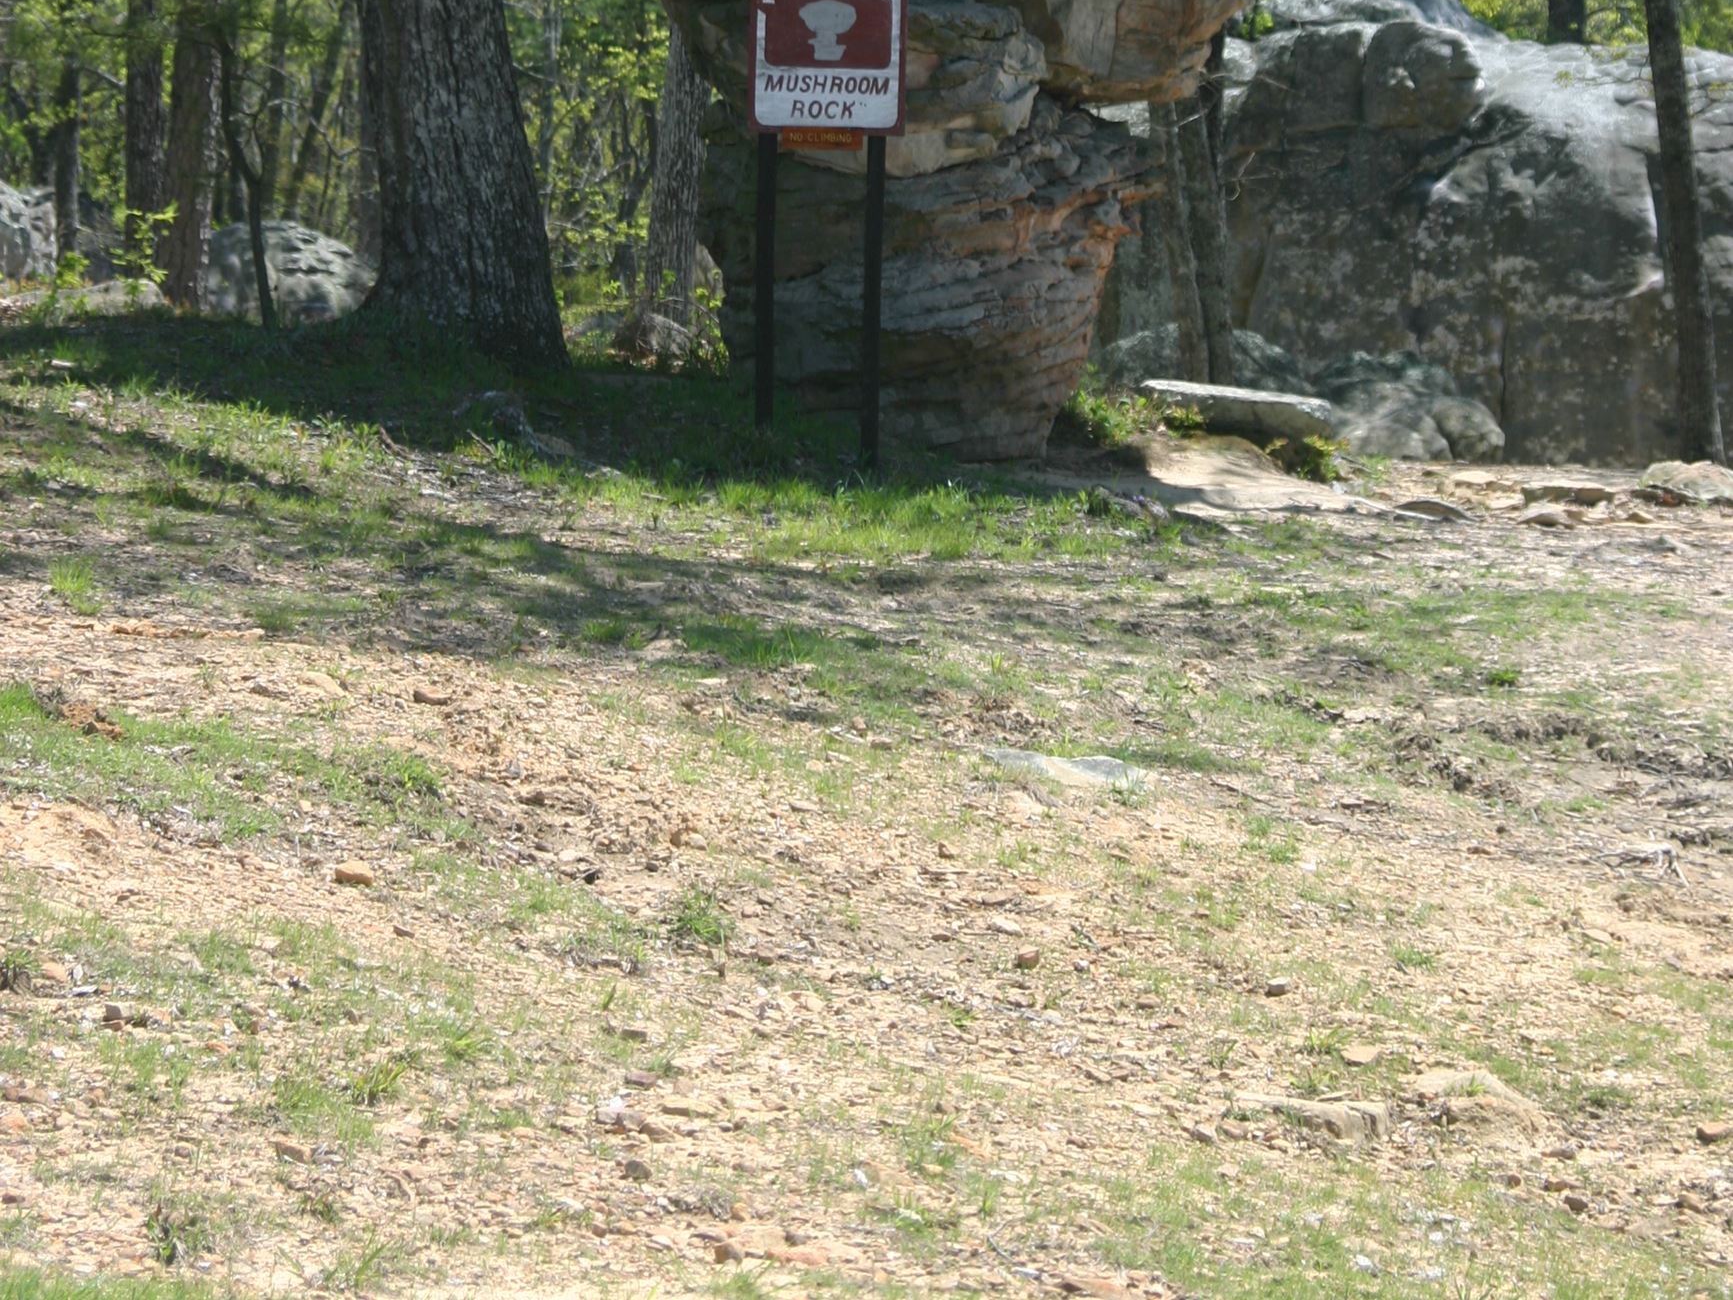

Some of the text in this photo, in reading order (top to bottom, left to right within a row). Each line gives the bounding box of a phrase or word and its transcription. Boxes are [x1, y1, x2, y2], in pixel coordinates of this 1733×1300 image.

[764, 74, 890, 95] MUSHROOM
[791, 99, 855, 119] ROCK
[789, 132, 853, 143] NO CLIMBING
